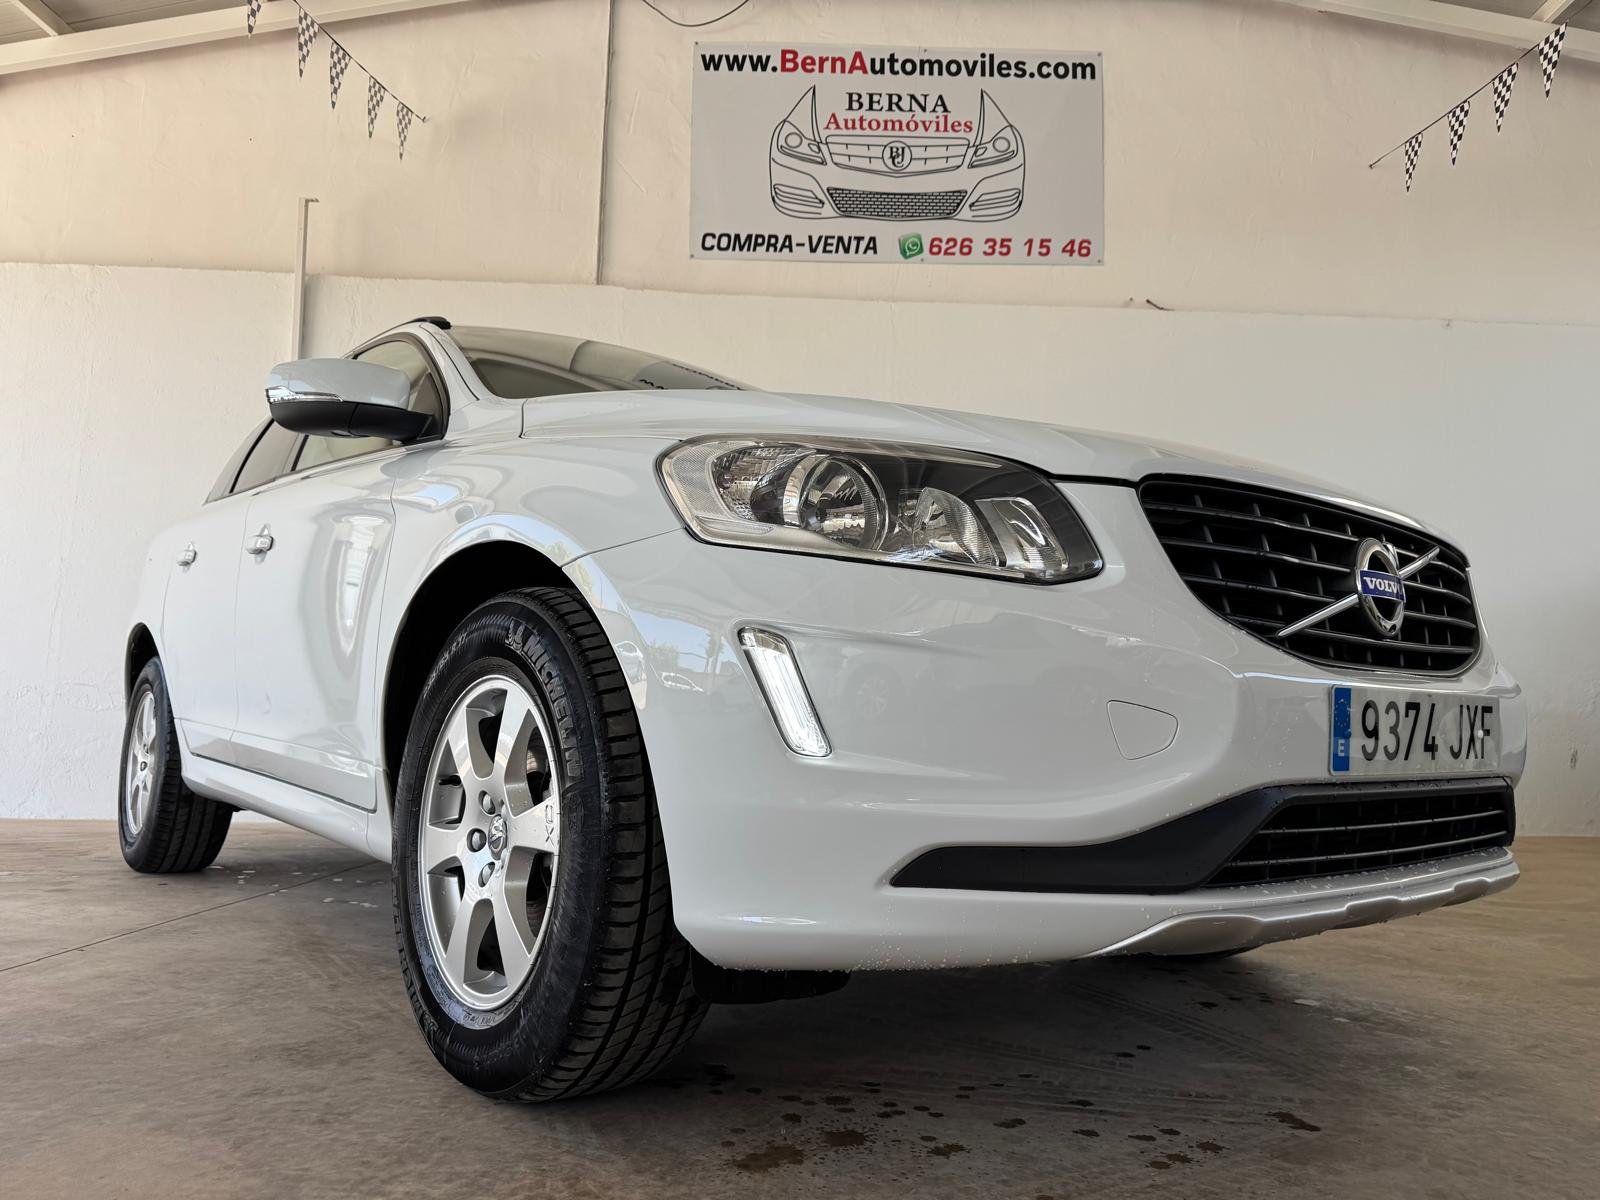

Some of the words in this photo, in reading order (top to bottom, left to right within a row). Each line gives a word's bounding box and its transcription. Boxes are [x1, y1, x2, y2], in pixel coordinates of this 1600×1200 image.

[701, 49, 1096, 80] www.BernAutomoviles.com
[845, 92, 951, 113] BERNA
[823, 112, 973, 133] Automóviles
[701, 233, 878, 255] COMPRA-VENTA
[928, 237, 974, 256] 626
[982, 237, 1012, 257] 35
[1023, 238, 1052, 257] 15
[1061, 239, 1092, 257] 46
[1361, 700, 1439, 761] 9374
[1450, 704, 1493, 760] JXF
[1337, 739, 1345, 757] E
